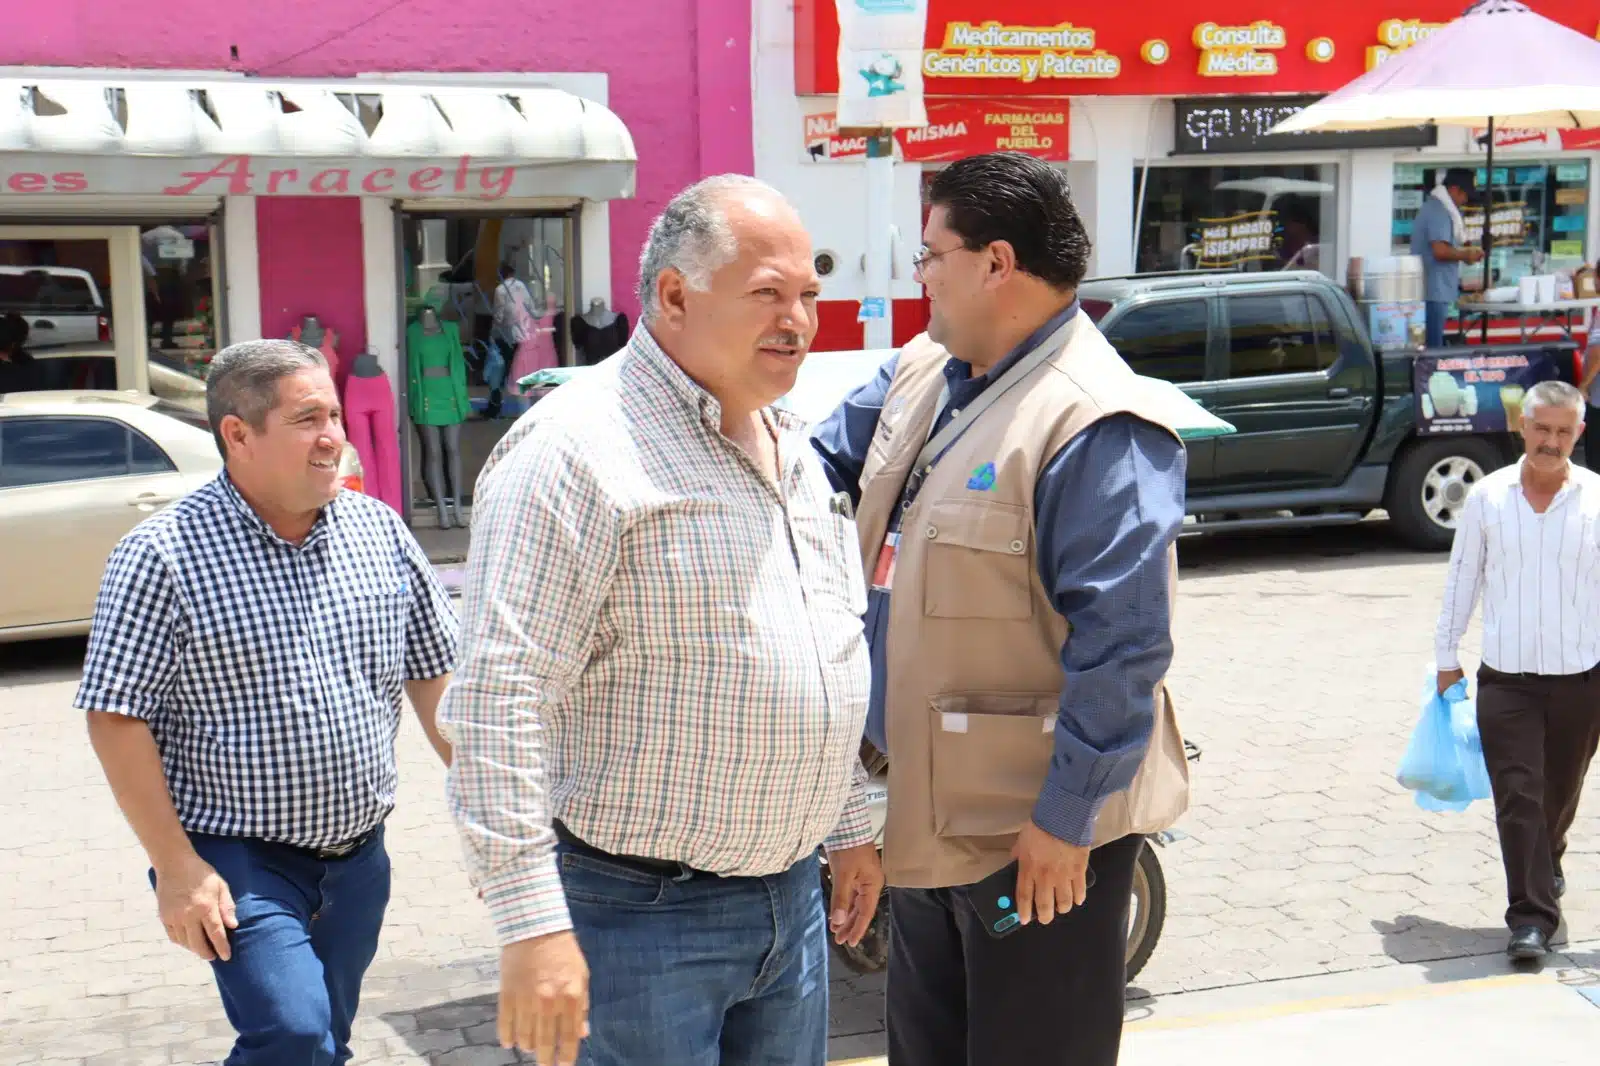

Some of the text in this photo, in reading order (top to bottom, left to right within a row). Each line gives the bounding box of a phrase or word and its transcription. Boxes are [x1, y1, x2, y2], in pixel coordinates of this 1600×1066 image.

[951, 25, 1092, 47] Medicamentos
[1201, 25, 1282, 45] Consulta
[1387, 22, 1437, 41] Orto
[924, 52, 1117, 77] Genéricos y Patente
[1208, 51, 1274, 72] Médica
[984, 113, 1065, 125] FARMACIAS
[906, 121, 968, 144] MISMA
[1010, 125, 1038, 137] DEL
[995, 136, 1053, 149] PUEBLO
[161, 154, 517, 200] Aracely
